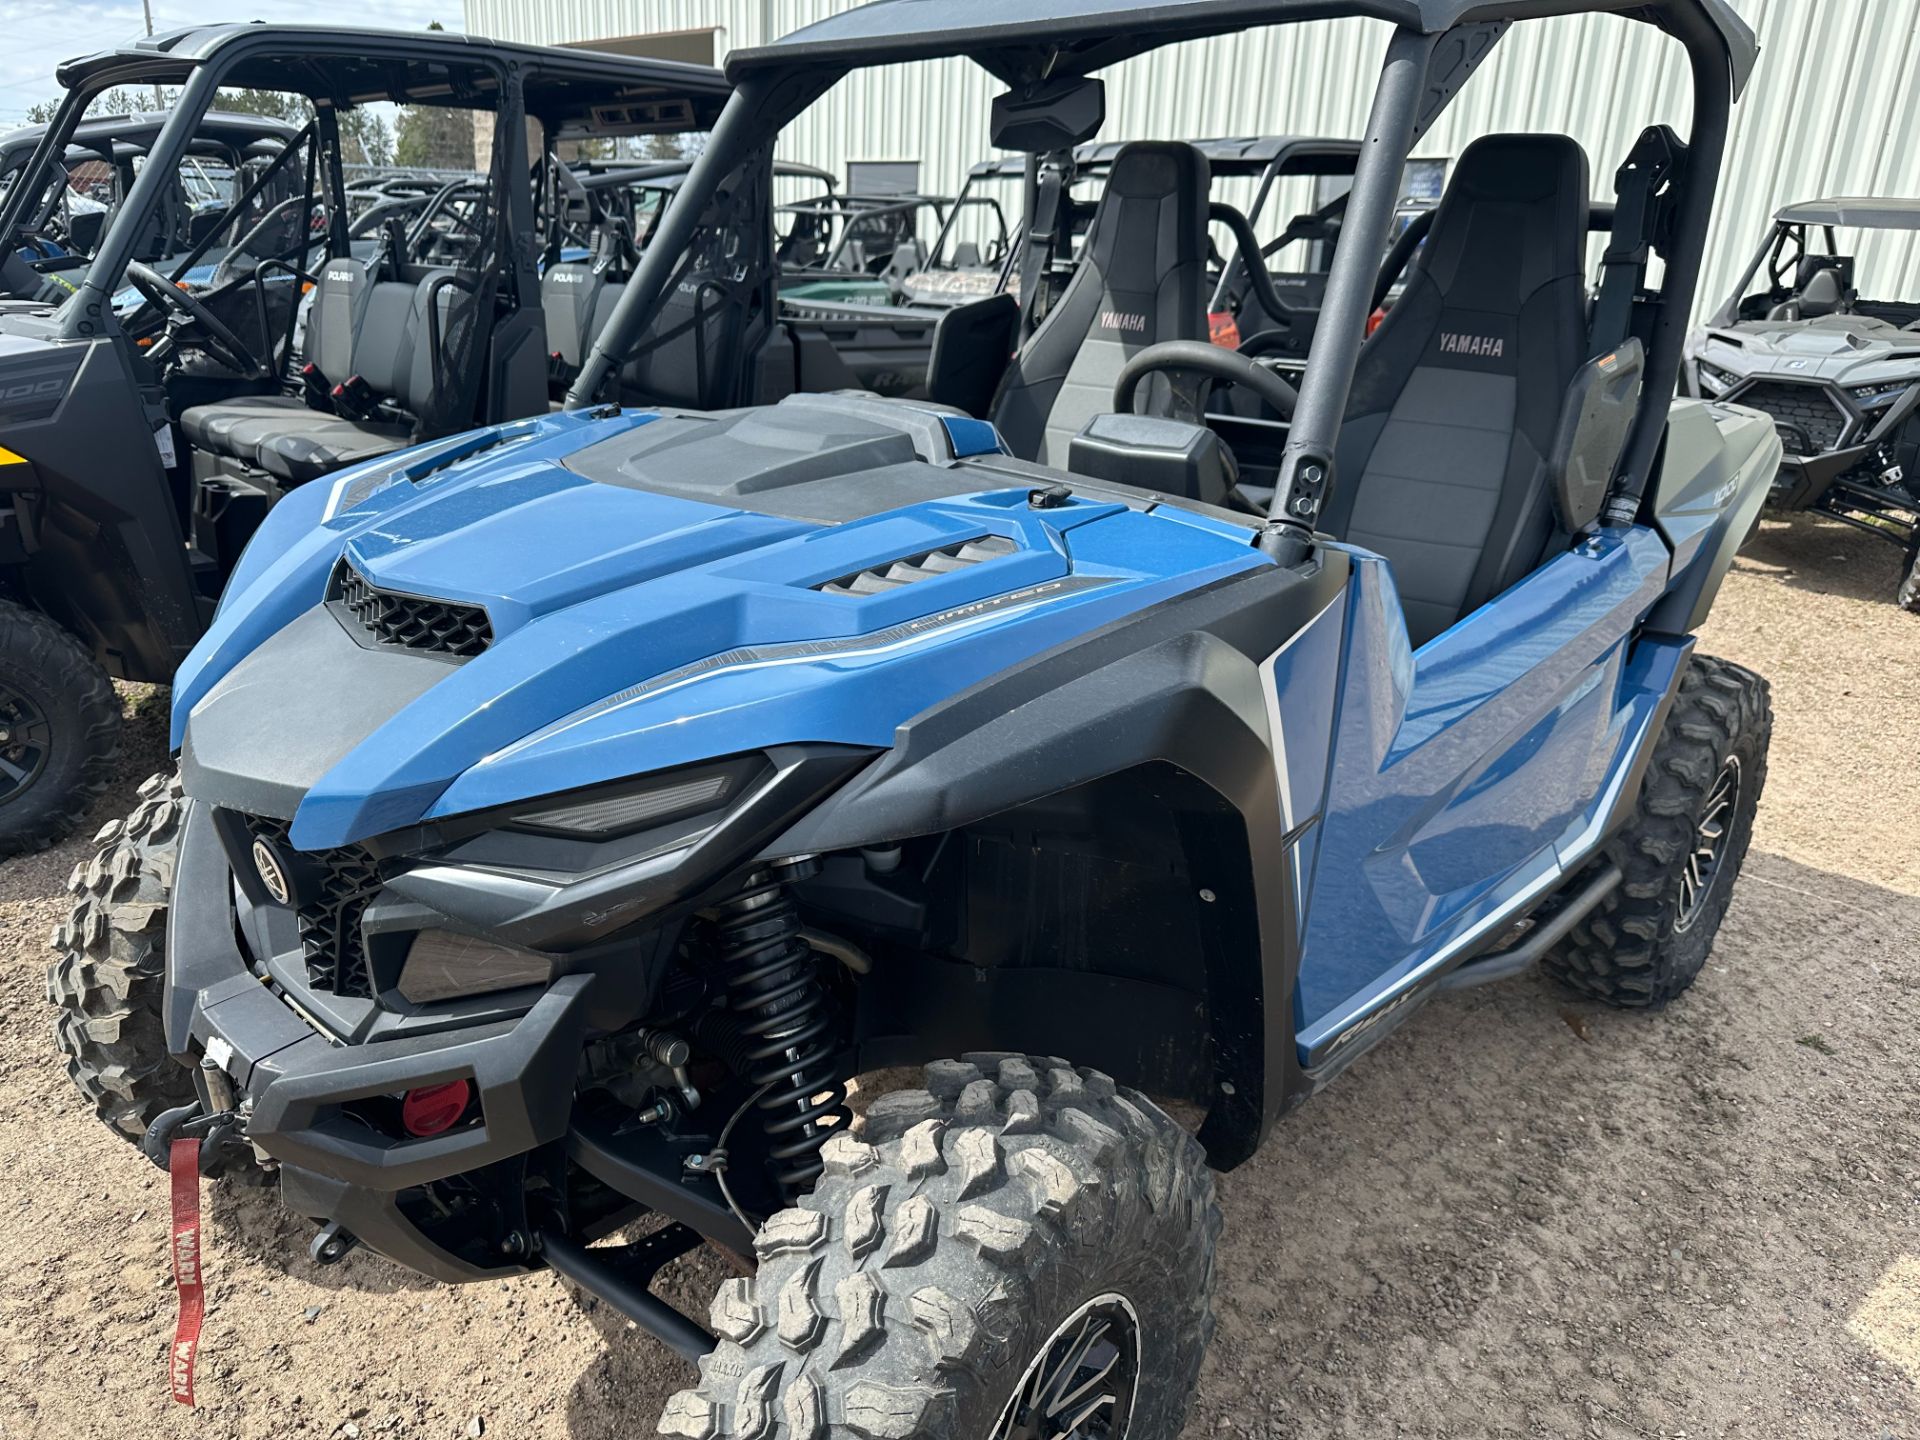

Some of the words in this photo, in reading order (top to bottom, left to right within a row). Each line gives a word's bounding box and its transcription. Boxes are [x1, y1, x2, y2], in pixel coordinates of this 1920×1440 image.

[327, 270, 354, 282] POLARIS
[553, 272, 584, 283] POLARIS
[1101, 311, 1146, 332] YAMAHA
[1440, 332, 1504, 357] YAMAHA
[175, 1228, 198, 1286] WARN
[173, 1340, 194, 1396] WARN
